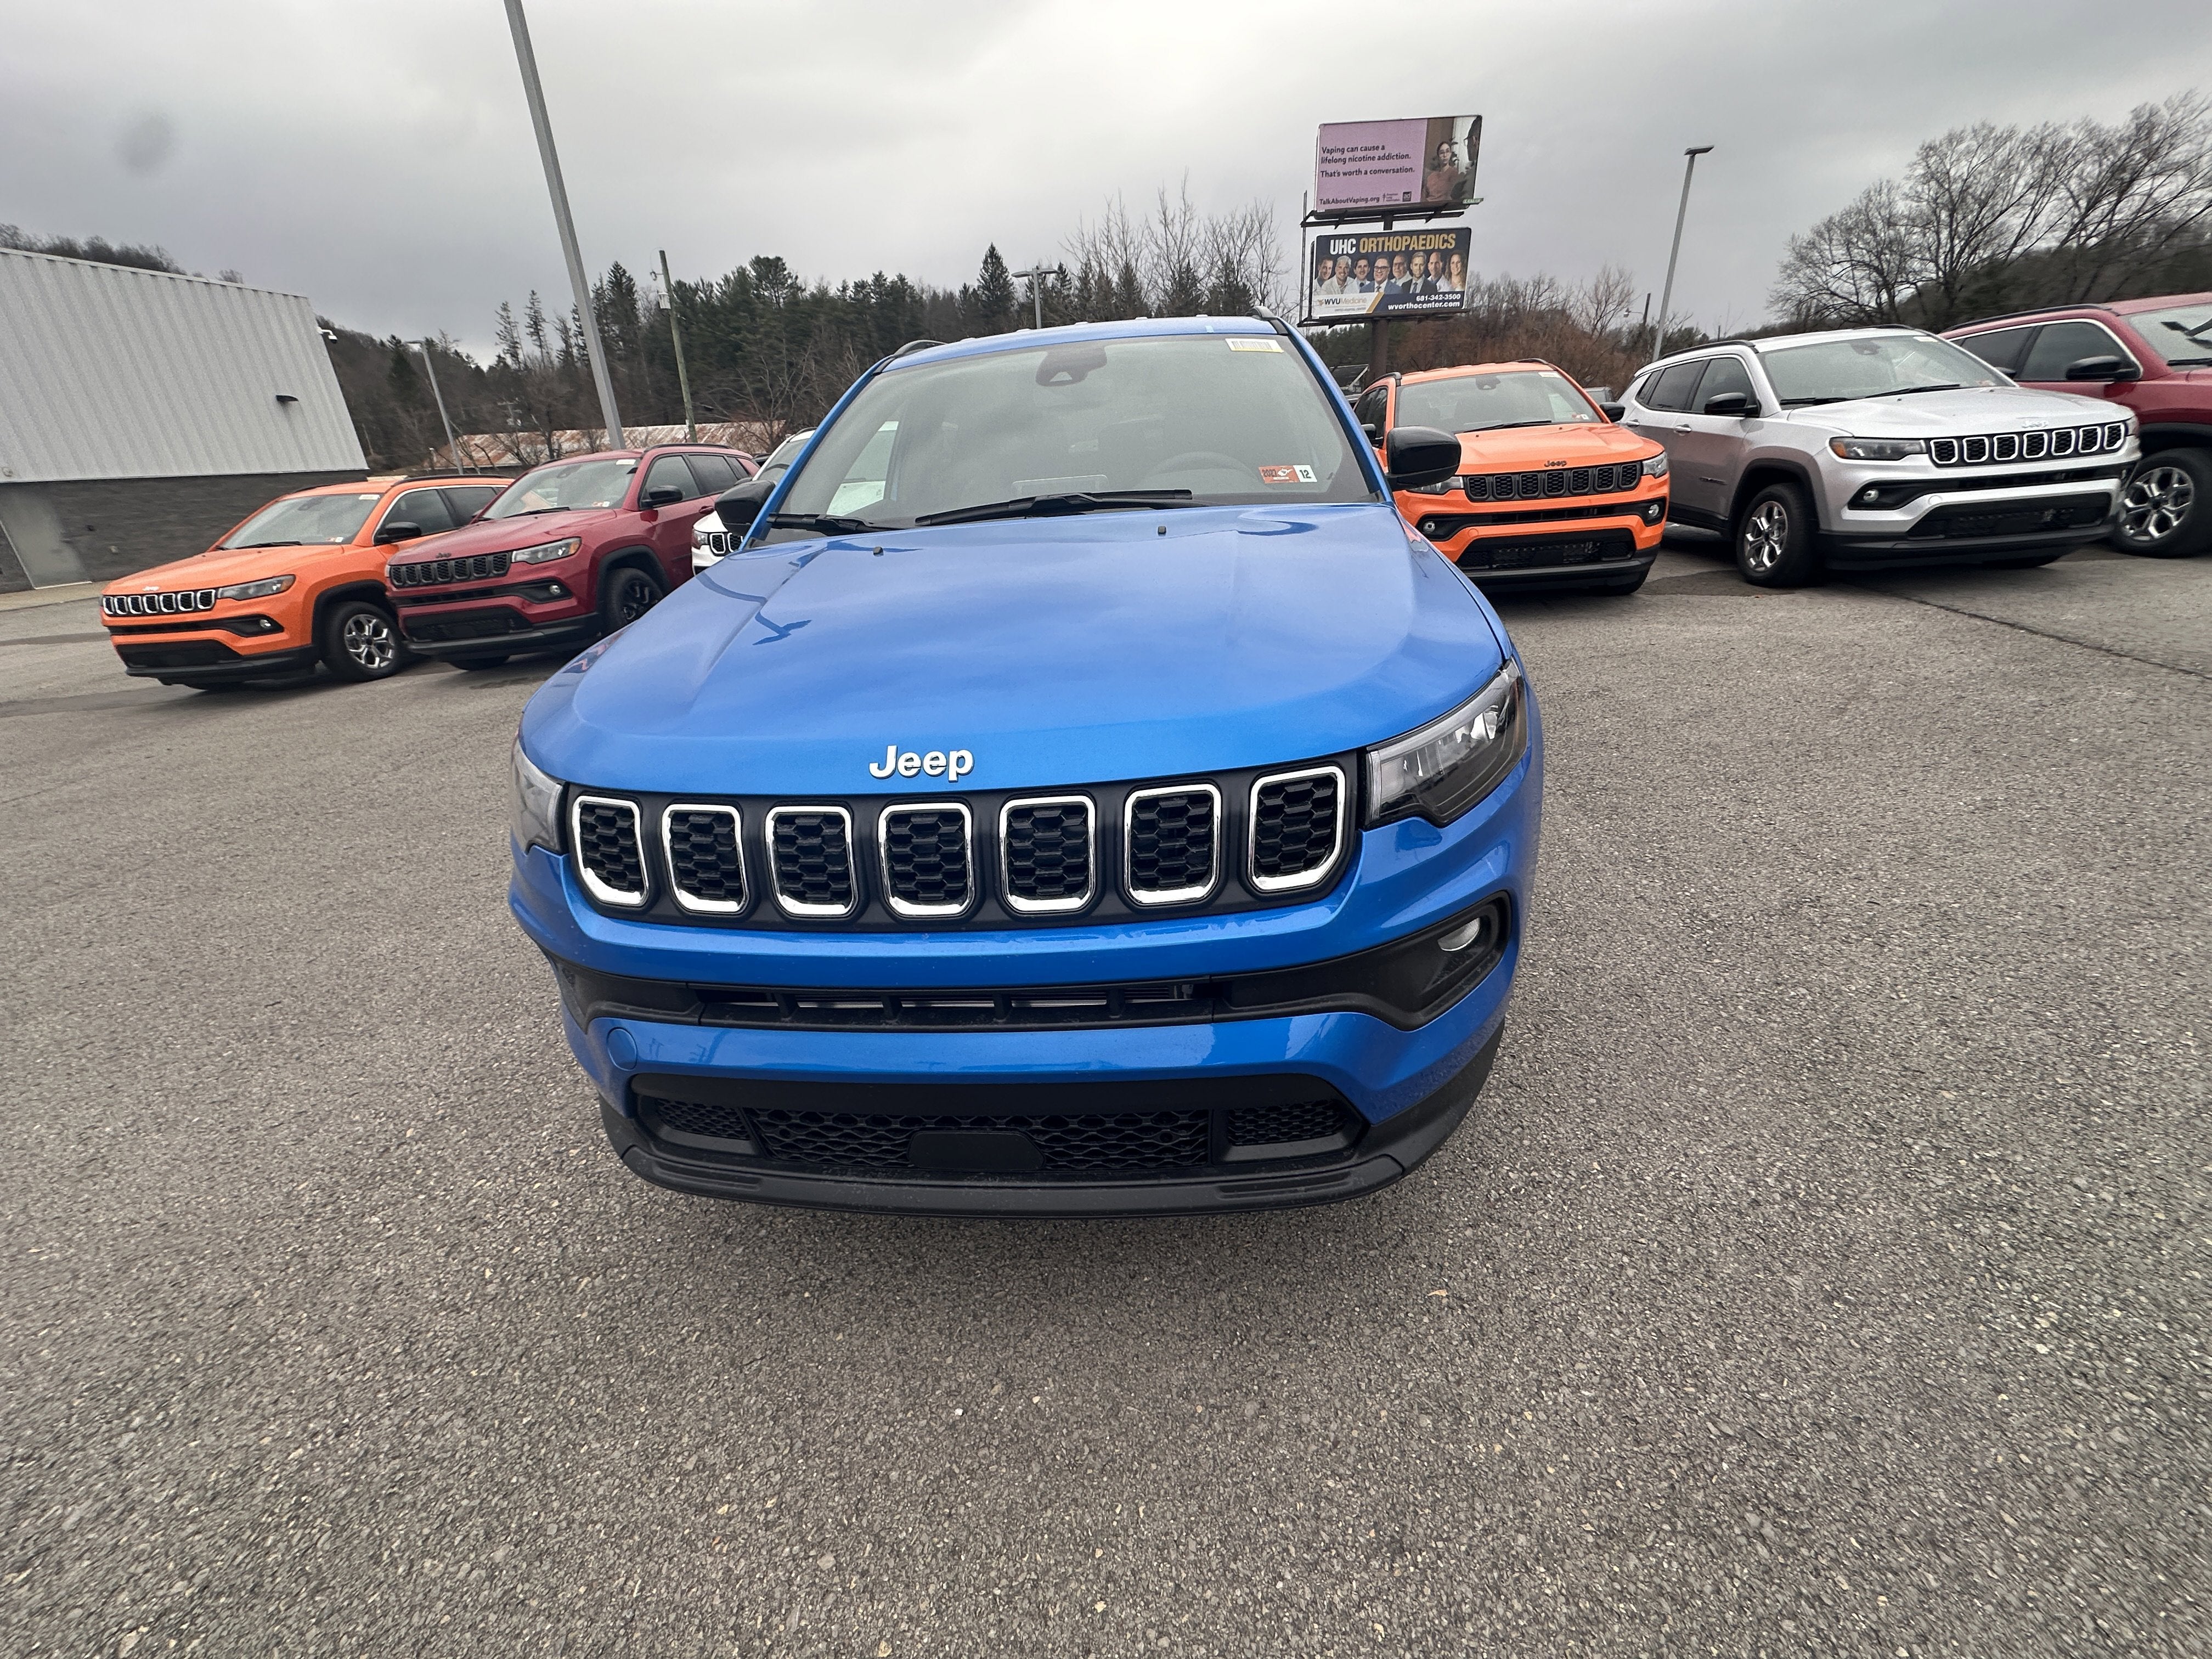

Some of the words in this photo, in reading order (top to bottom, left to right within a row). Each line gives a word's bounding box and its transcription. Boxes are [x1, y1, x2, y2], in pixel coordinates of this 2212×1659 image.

[1322, 146, 1345, 155] Vaping
[1321, 156, 1346, 165] lifelong
[1348, 154, 1376, 162] nicotine
[1377, 153, 1411, 161] addiction.
[1321, 170, 1341, 178] That's
[1342, 168, 1362, 176] worth
[1369, 166, 1415, 174] conversation.
[1319, 196, 1380, 205] TalkAboutVaping.org
[1330, 238, 1356, 255] UHC
[1359, 234, 1456, 253] ORTHOPAEDICS
[1388, 301, 1460, 310] wvorthocenter.com
[1299, 470, 1312, 479] 12
[869, 744, 975, 783] Jeep
